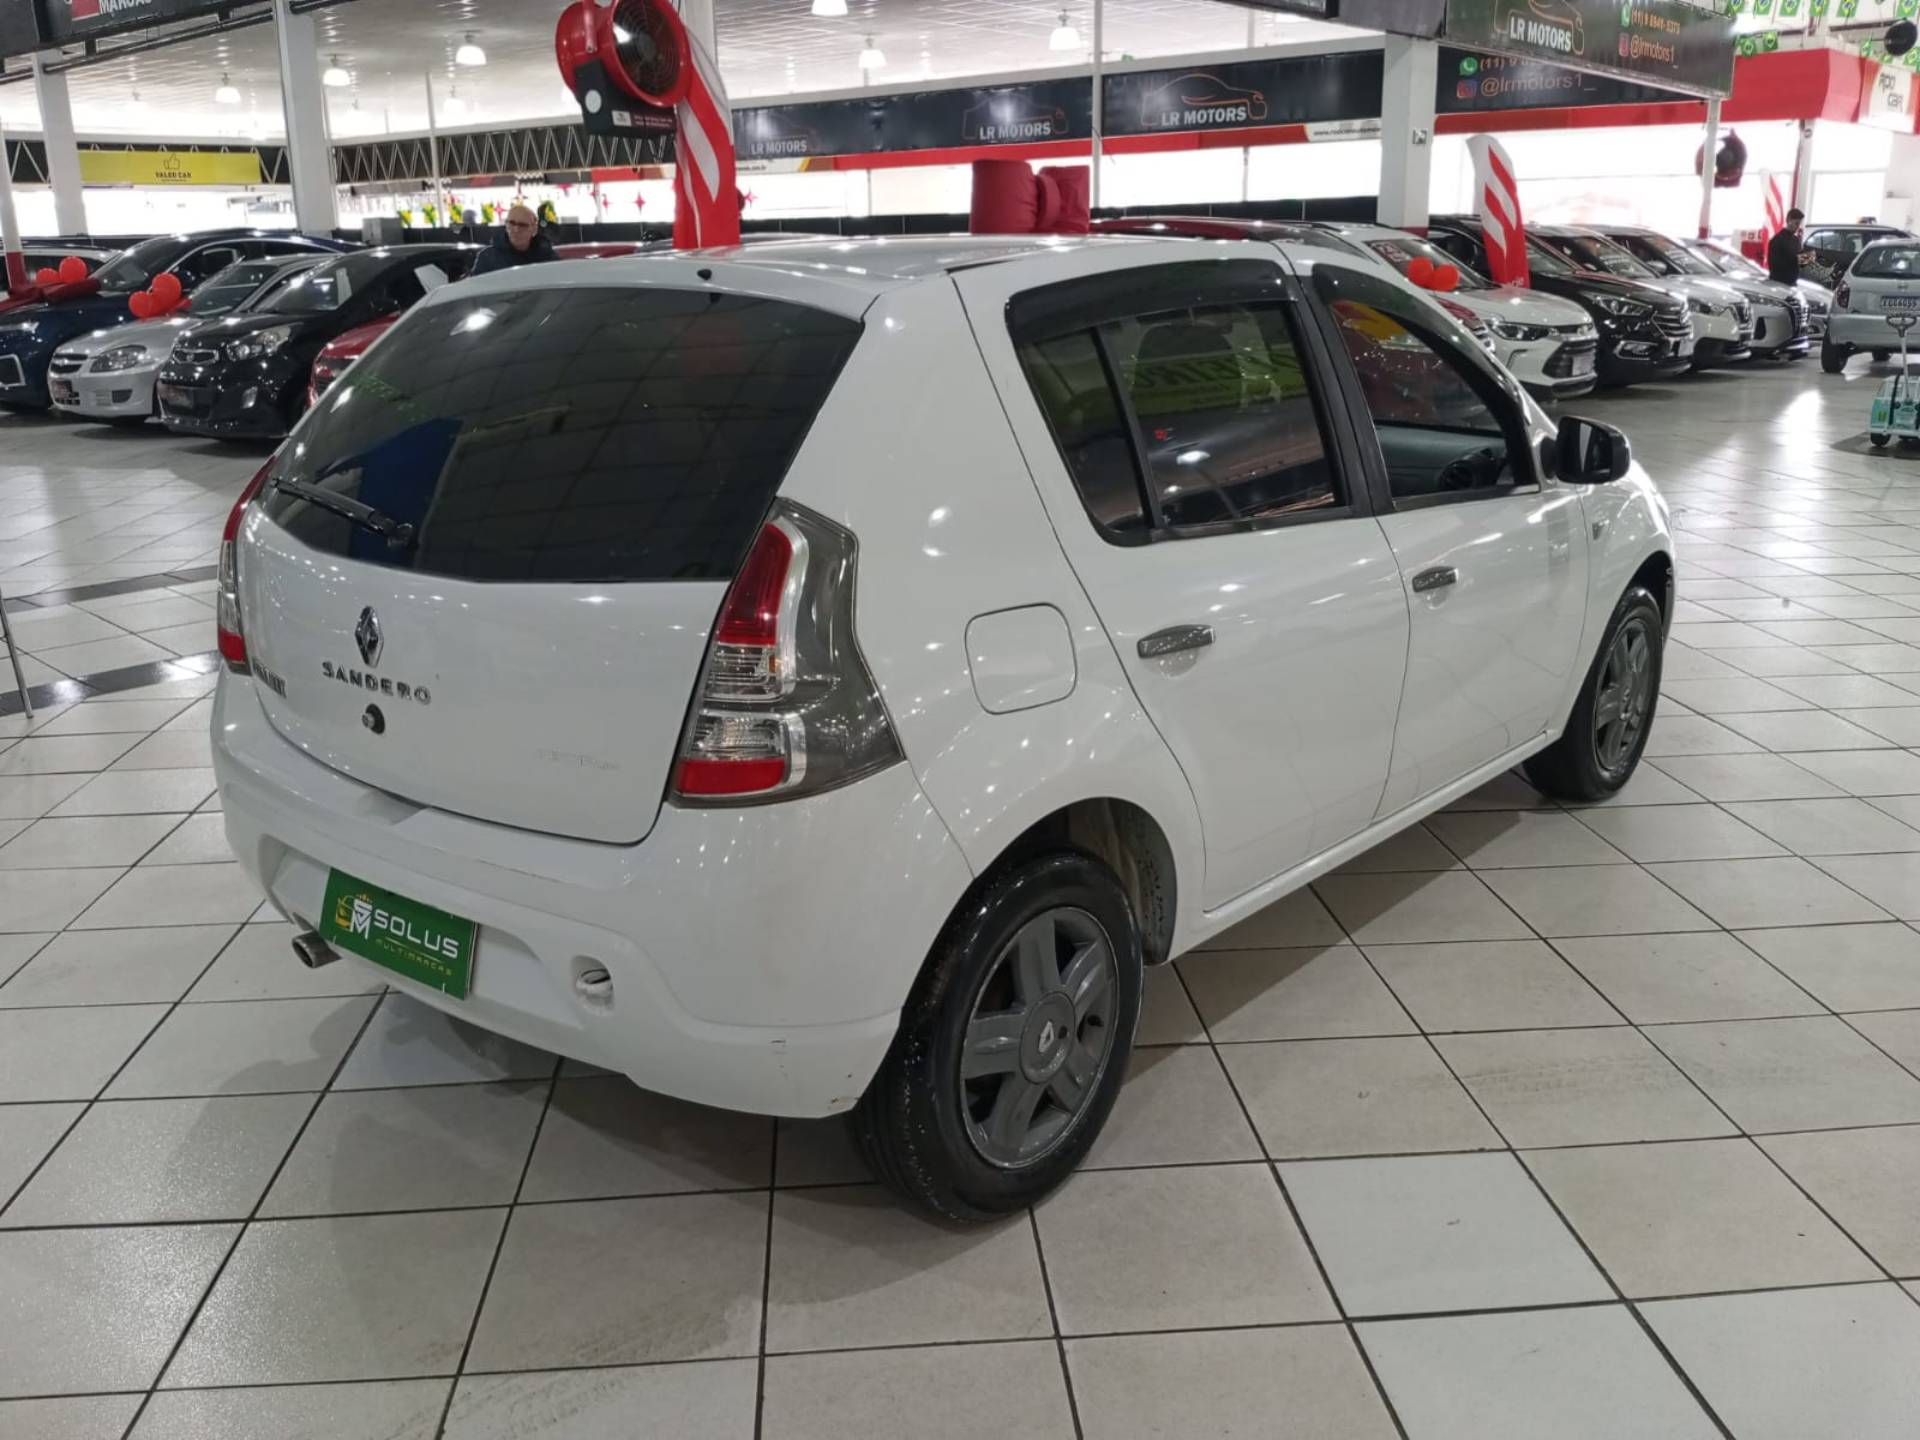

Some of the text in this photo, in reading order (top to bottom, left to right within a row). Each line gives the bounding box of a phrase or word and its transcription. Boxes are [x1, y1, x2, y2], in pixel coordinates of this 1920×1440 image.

[1510, 17, 1572, 53] LR MOTORS
[1160, 106, 1247, 126] LR MOTORS
[979, 121, 1052, 140] LR MOTORS
[750, 139, 808, 155] LR MOTORS
[321, 660, 431, 705] SANDERO
[373, 908, 459, 959] SOLUS
